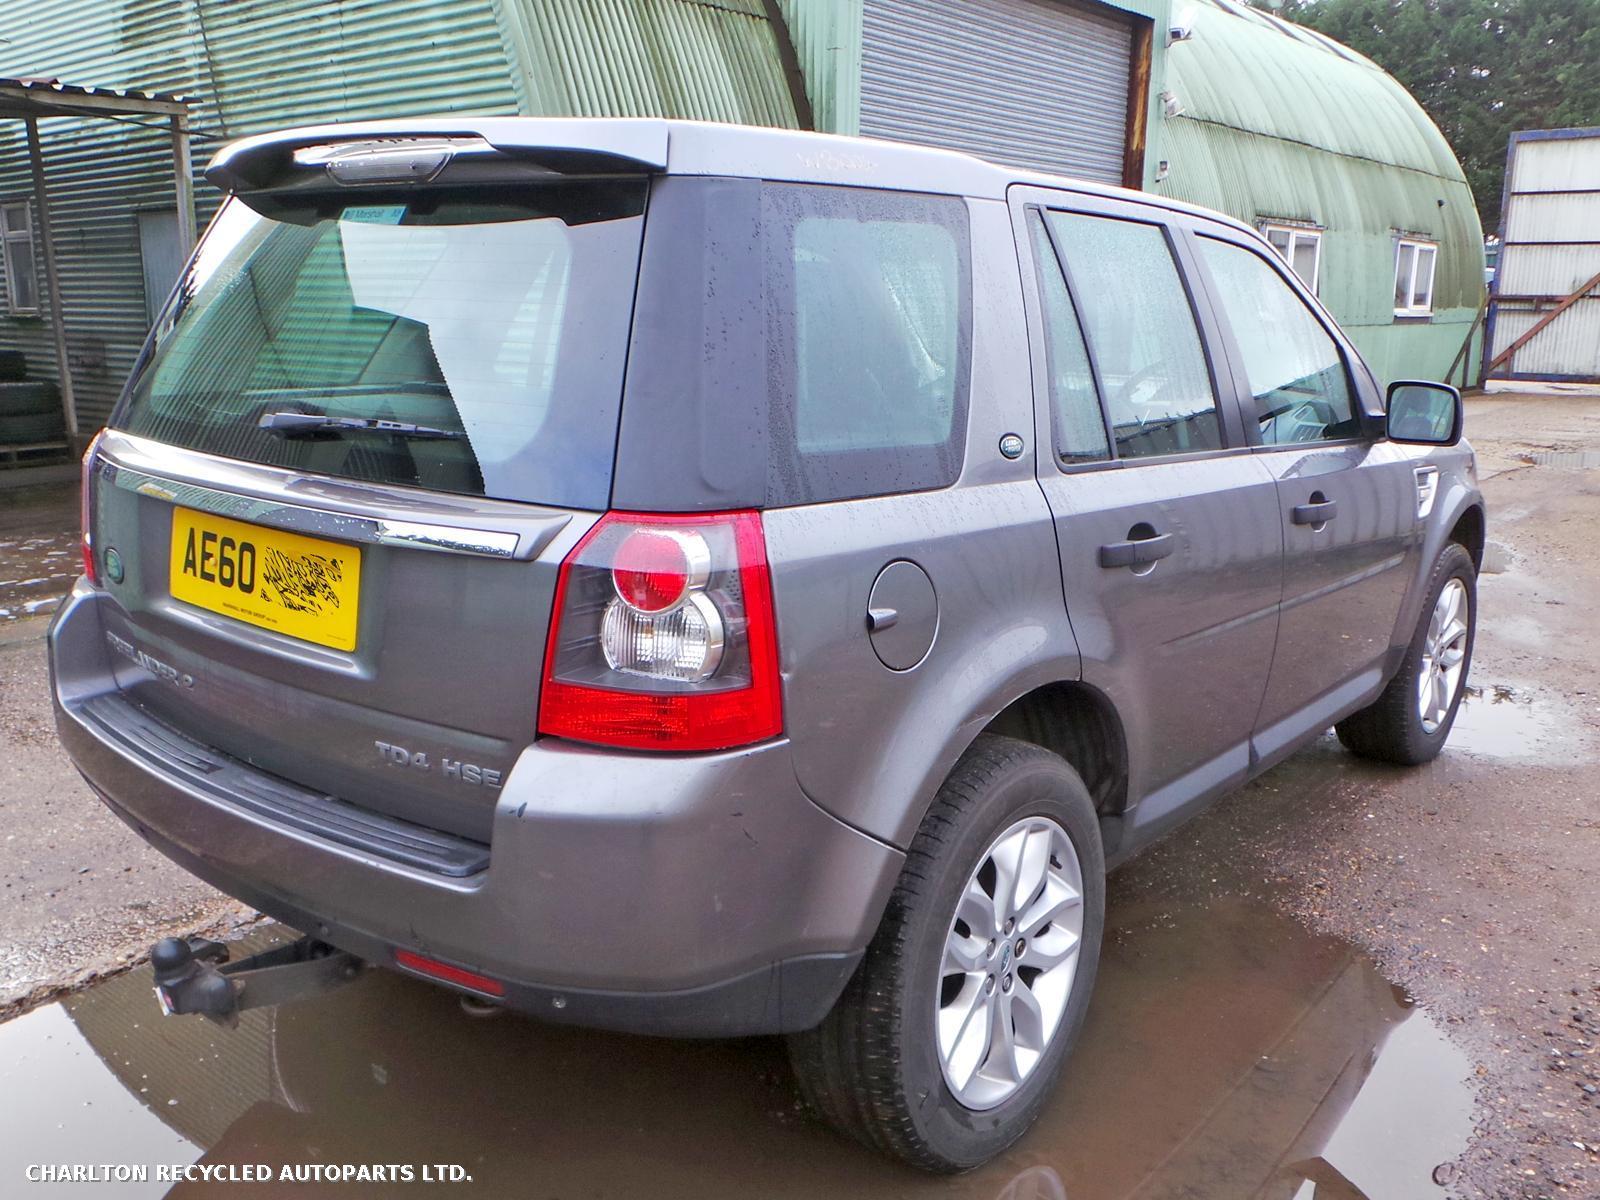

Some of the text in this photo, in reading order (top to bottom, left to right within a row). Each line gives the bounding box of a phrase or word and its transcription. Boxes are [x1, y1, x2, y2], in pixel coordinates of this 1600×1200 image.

[183, 526, 257, 595] AE60
[374, 740, 502, 789] TD4 HSE
